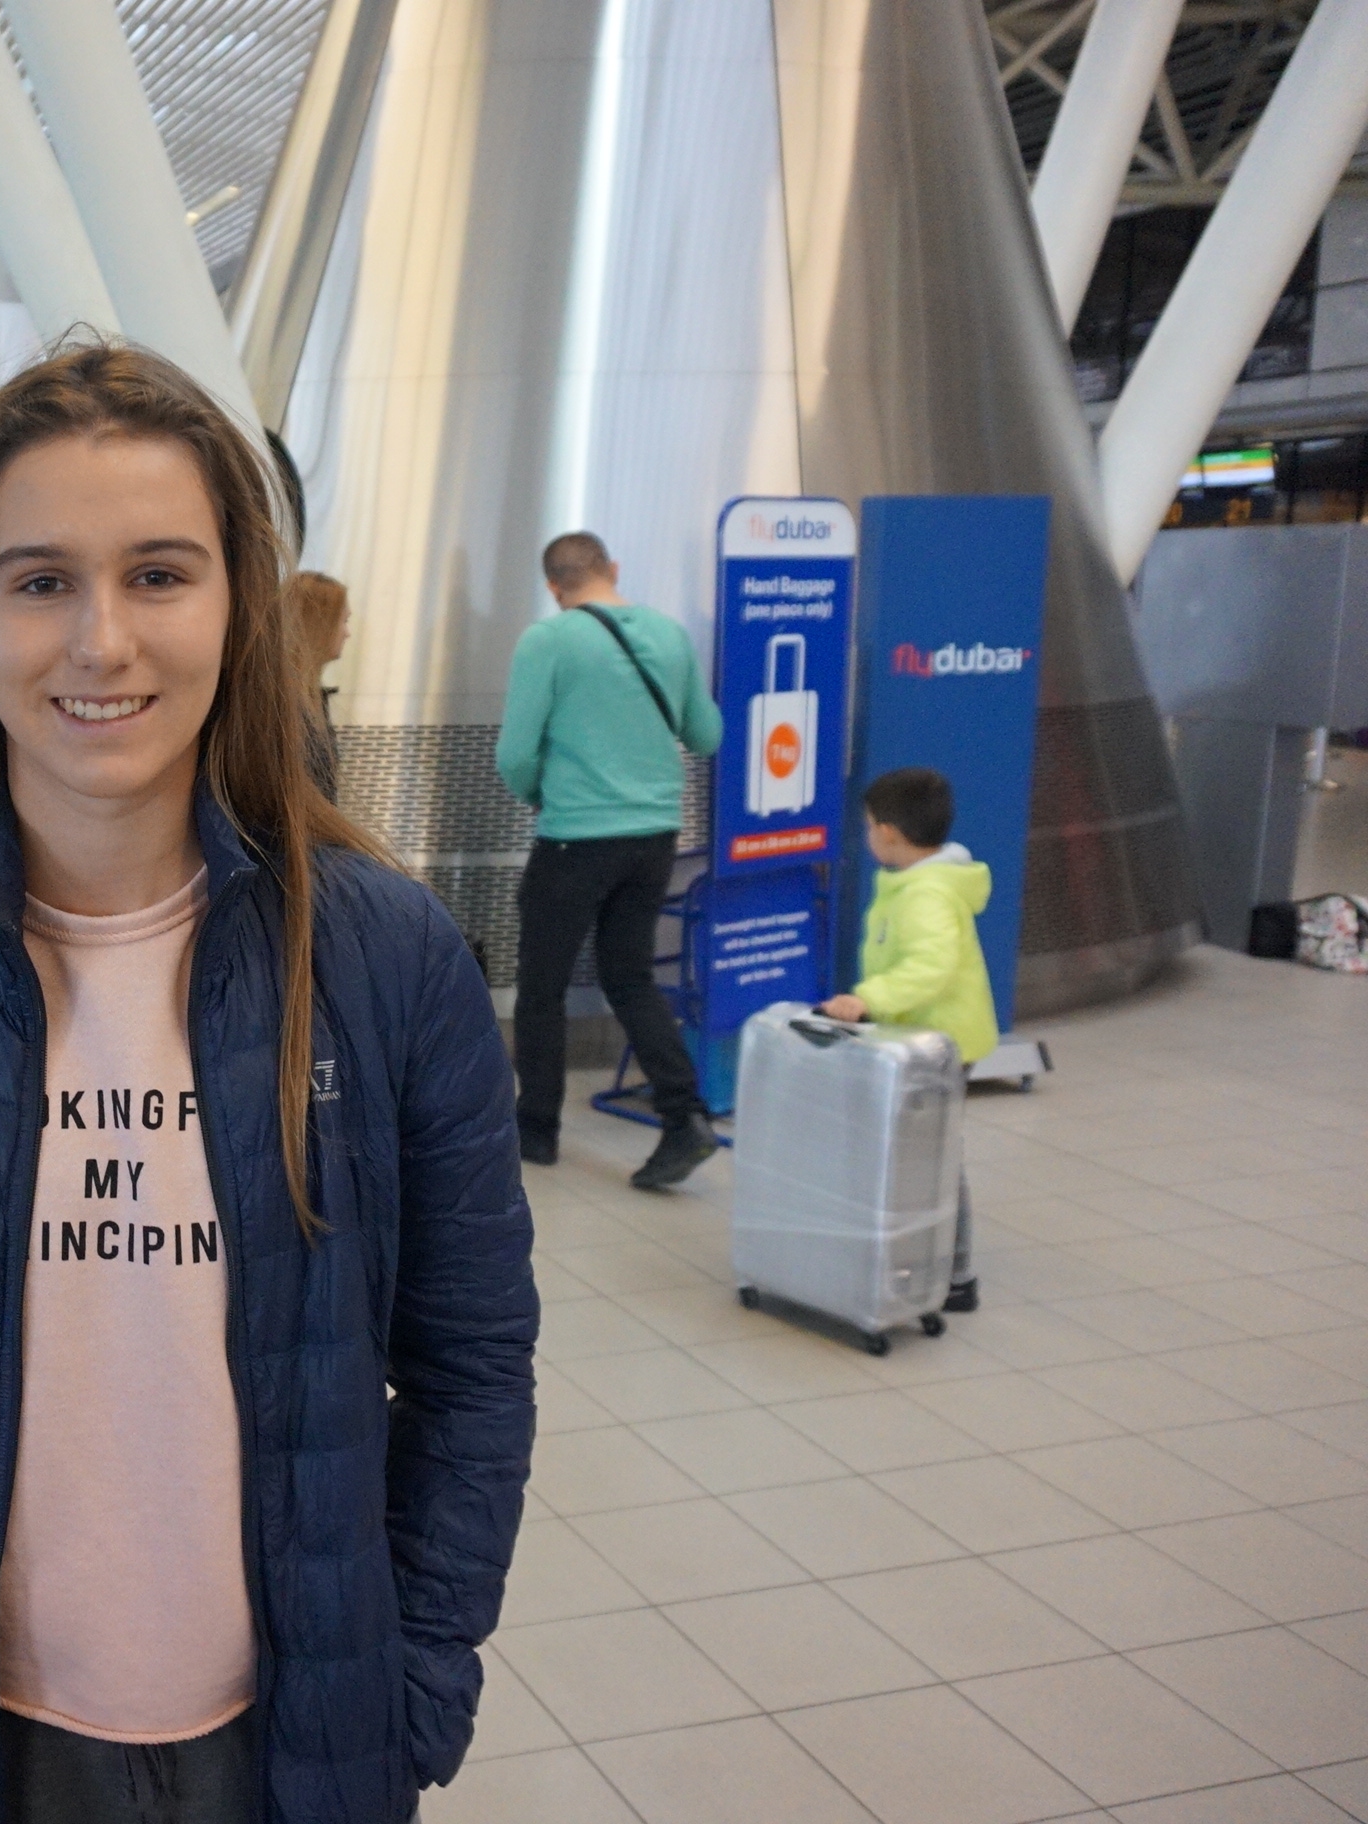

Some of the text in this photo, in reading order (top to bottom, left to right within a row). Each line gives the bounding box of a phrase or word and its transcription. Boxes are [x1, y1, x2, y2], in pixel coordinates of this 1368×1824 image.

[744, 576, 835, 598] Hand Baggage
[894, 641, 1032, 678] flydubai
[84, 1159, 144, 1201] MY
